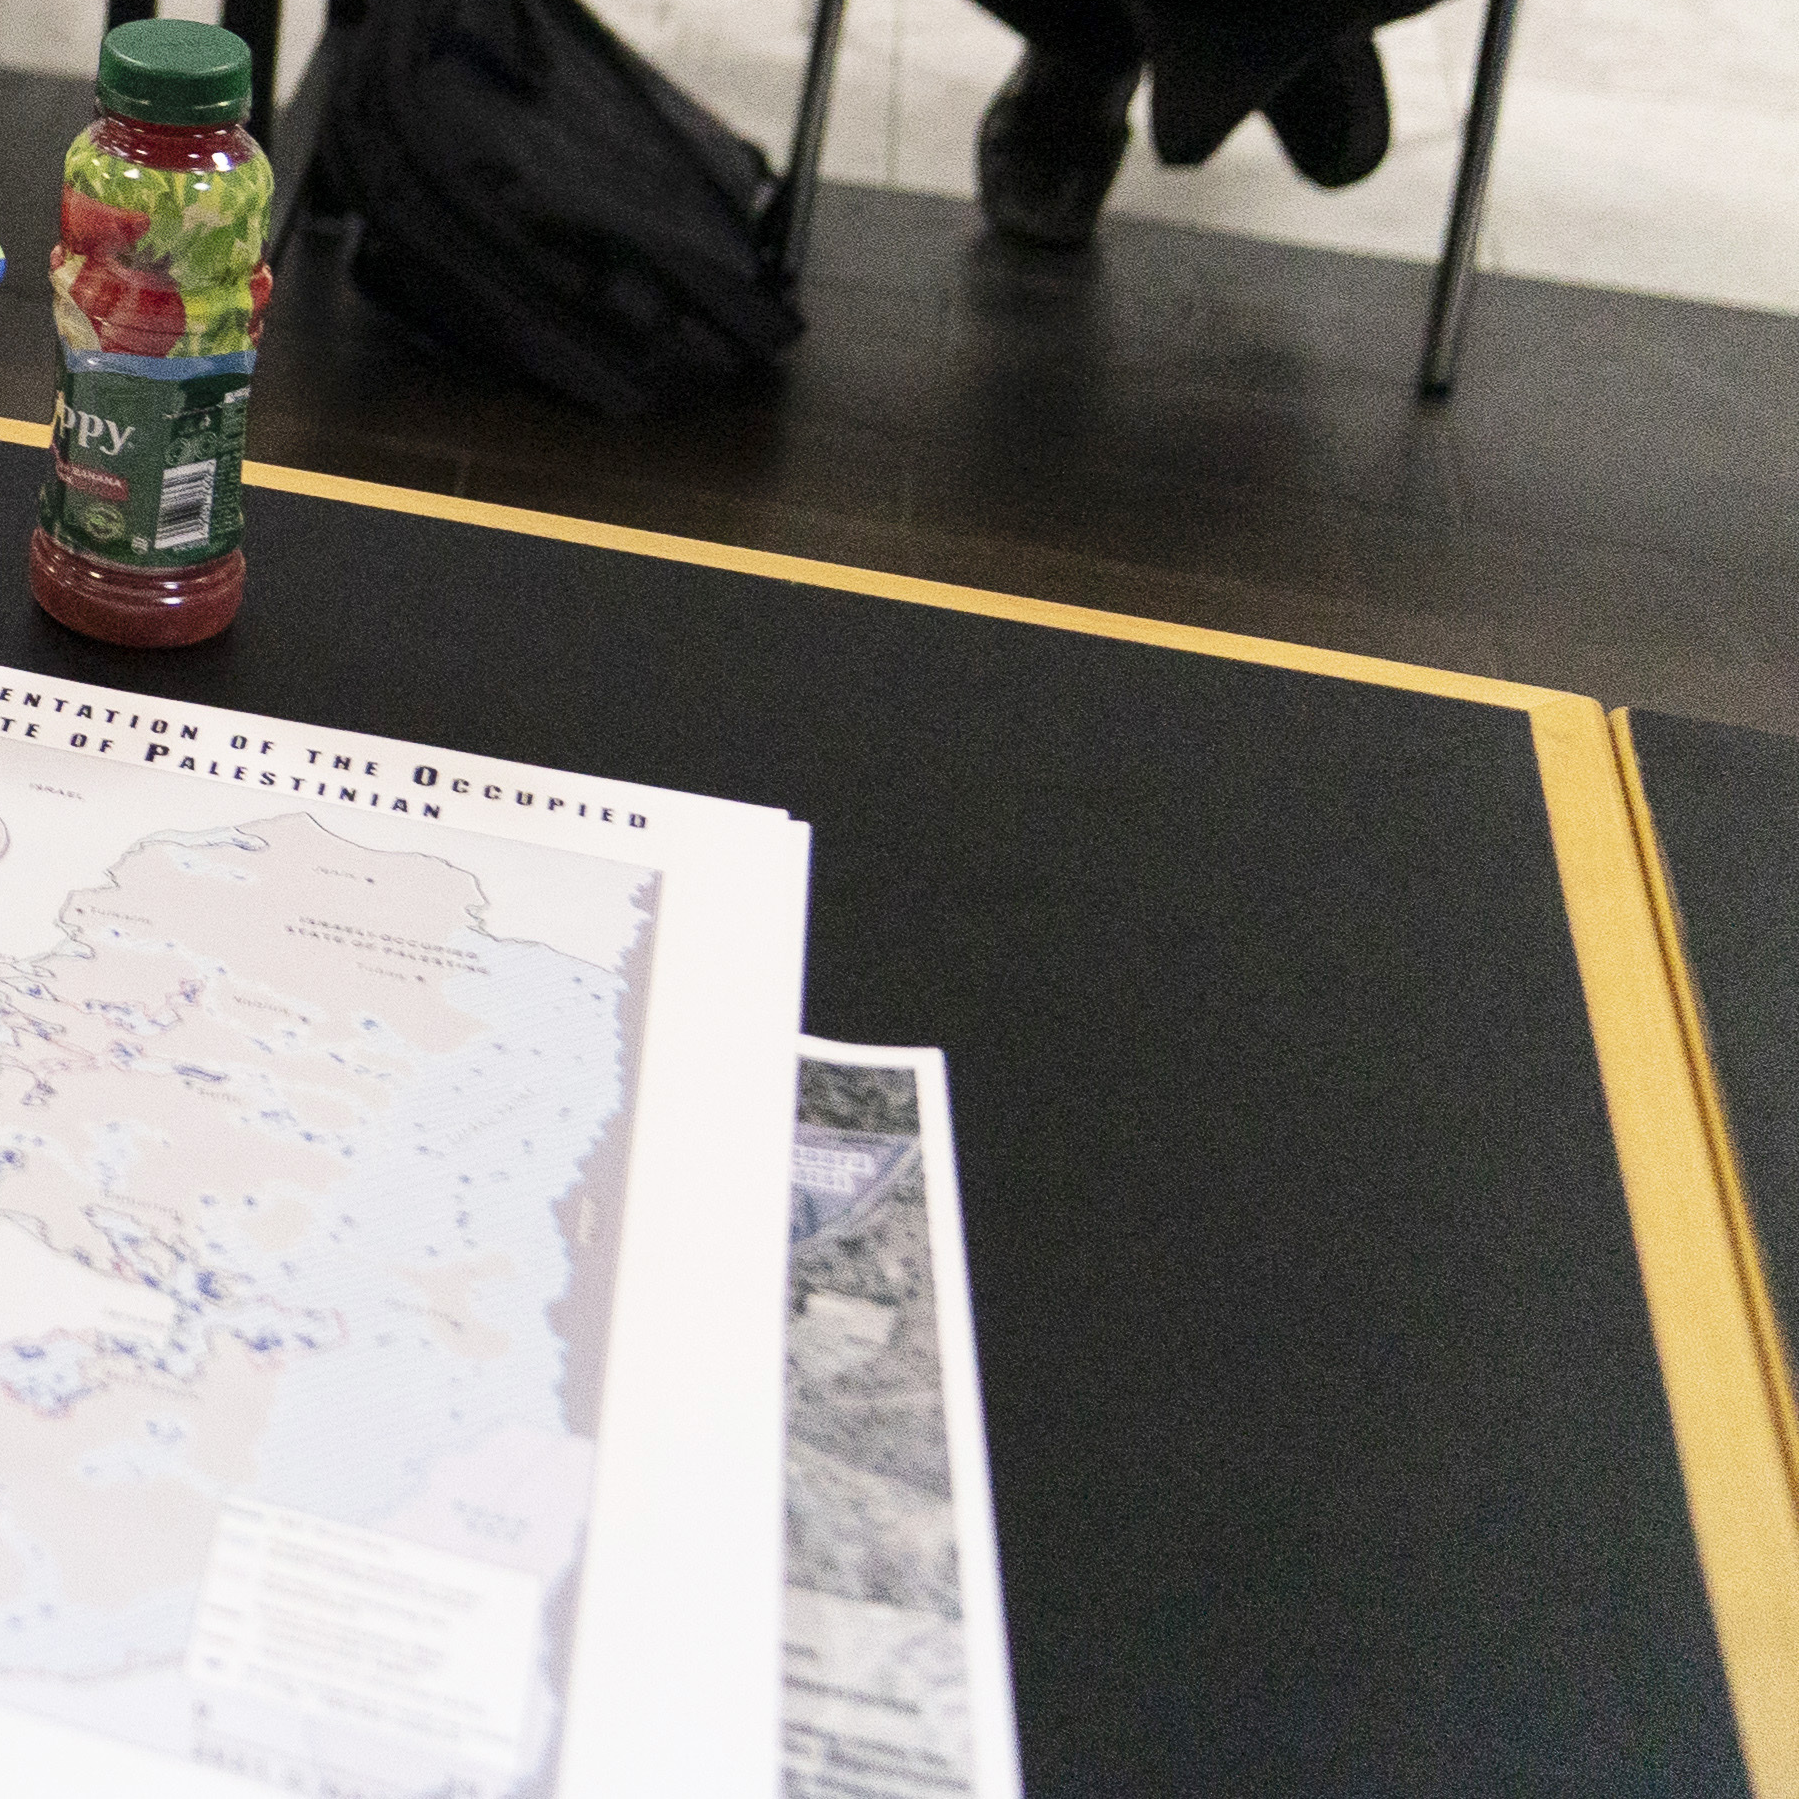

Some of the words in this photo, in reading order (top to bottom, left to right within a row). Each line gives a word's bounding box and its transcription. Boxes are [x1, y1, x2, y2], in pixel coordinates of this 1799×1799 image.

[69, 731, 117, 758] OF
[143, 738, 445, 823] PALESTINIAN
[230, 733, 279, 757] OF
[305, 748, 383, 779] THE
[412, 762, 652, 834] OCCUPIED
